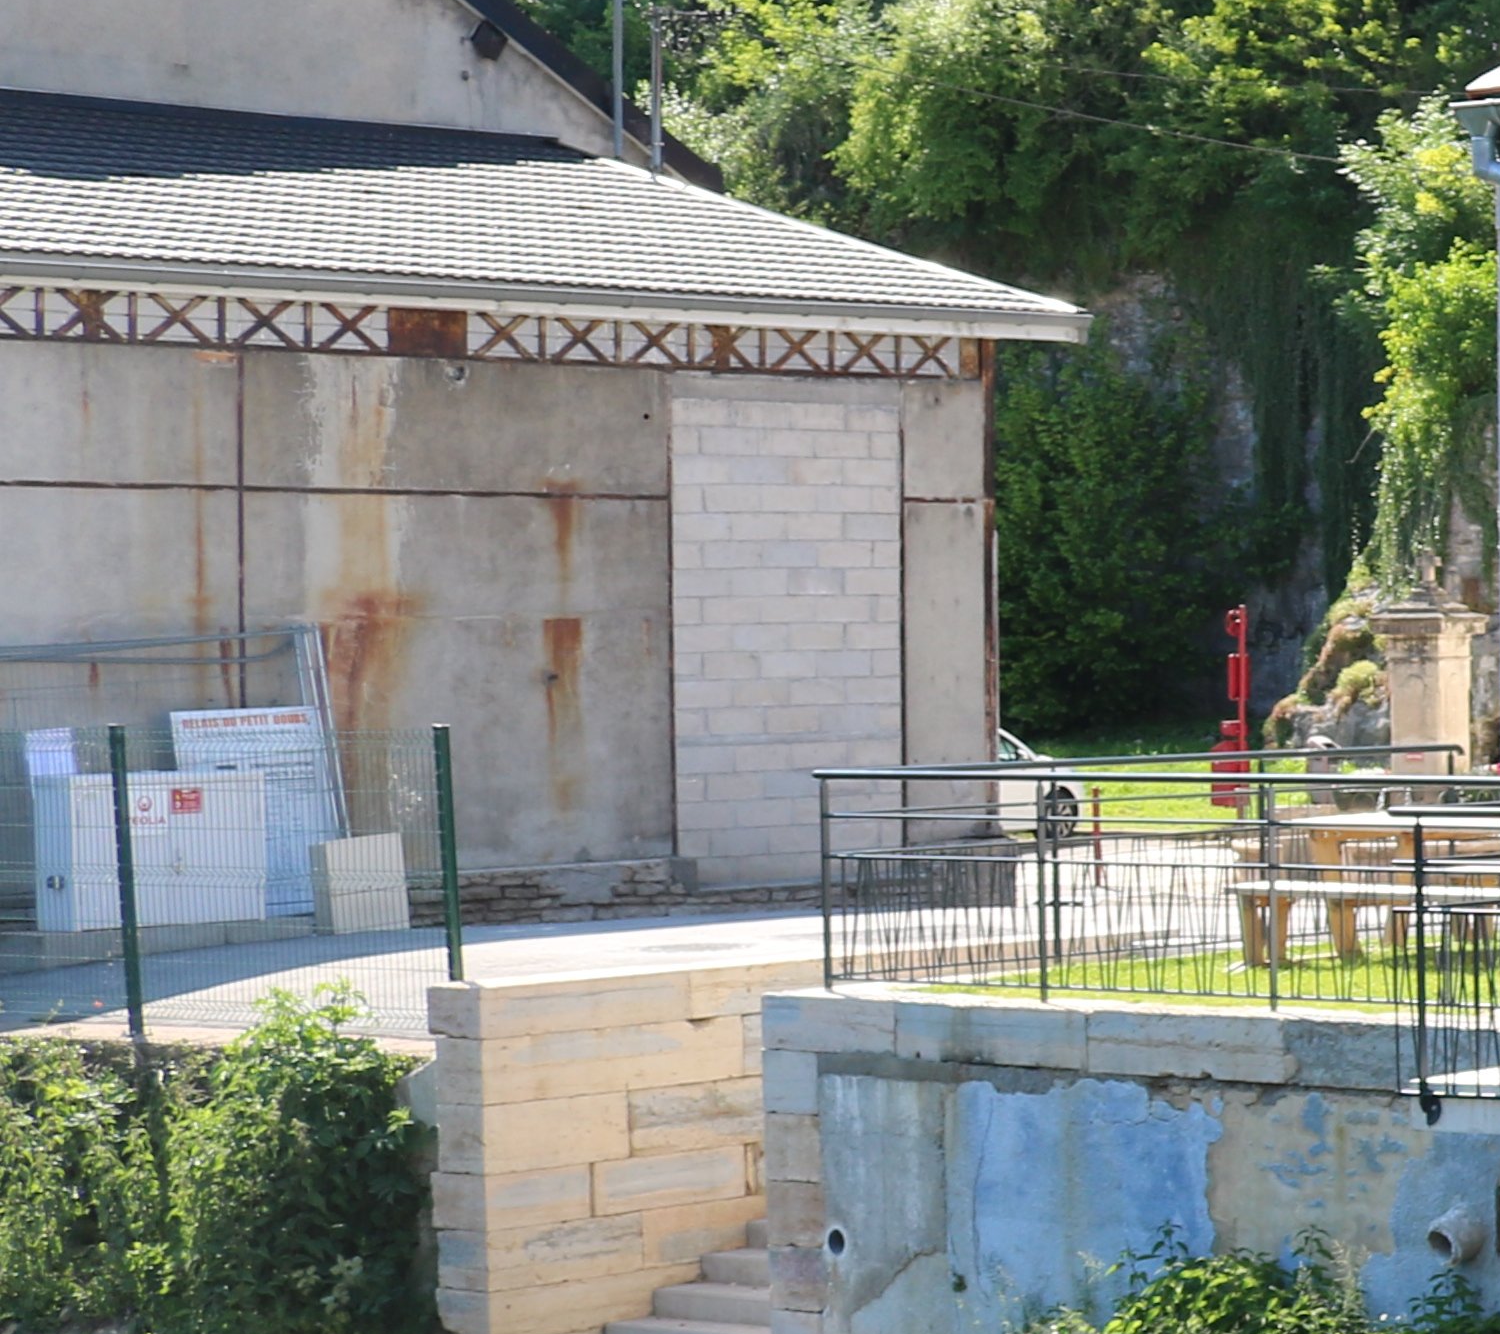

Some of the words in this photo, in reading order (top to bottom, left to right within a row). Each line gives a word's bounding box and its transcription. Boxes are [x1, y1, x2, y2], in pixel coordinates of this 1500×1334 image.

[181, 718, 219, 728] RELAIS
[240, 715, 268, 726] PETIT
[128, 815, 167, 825] EOLIA
